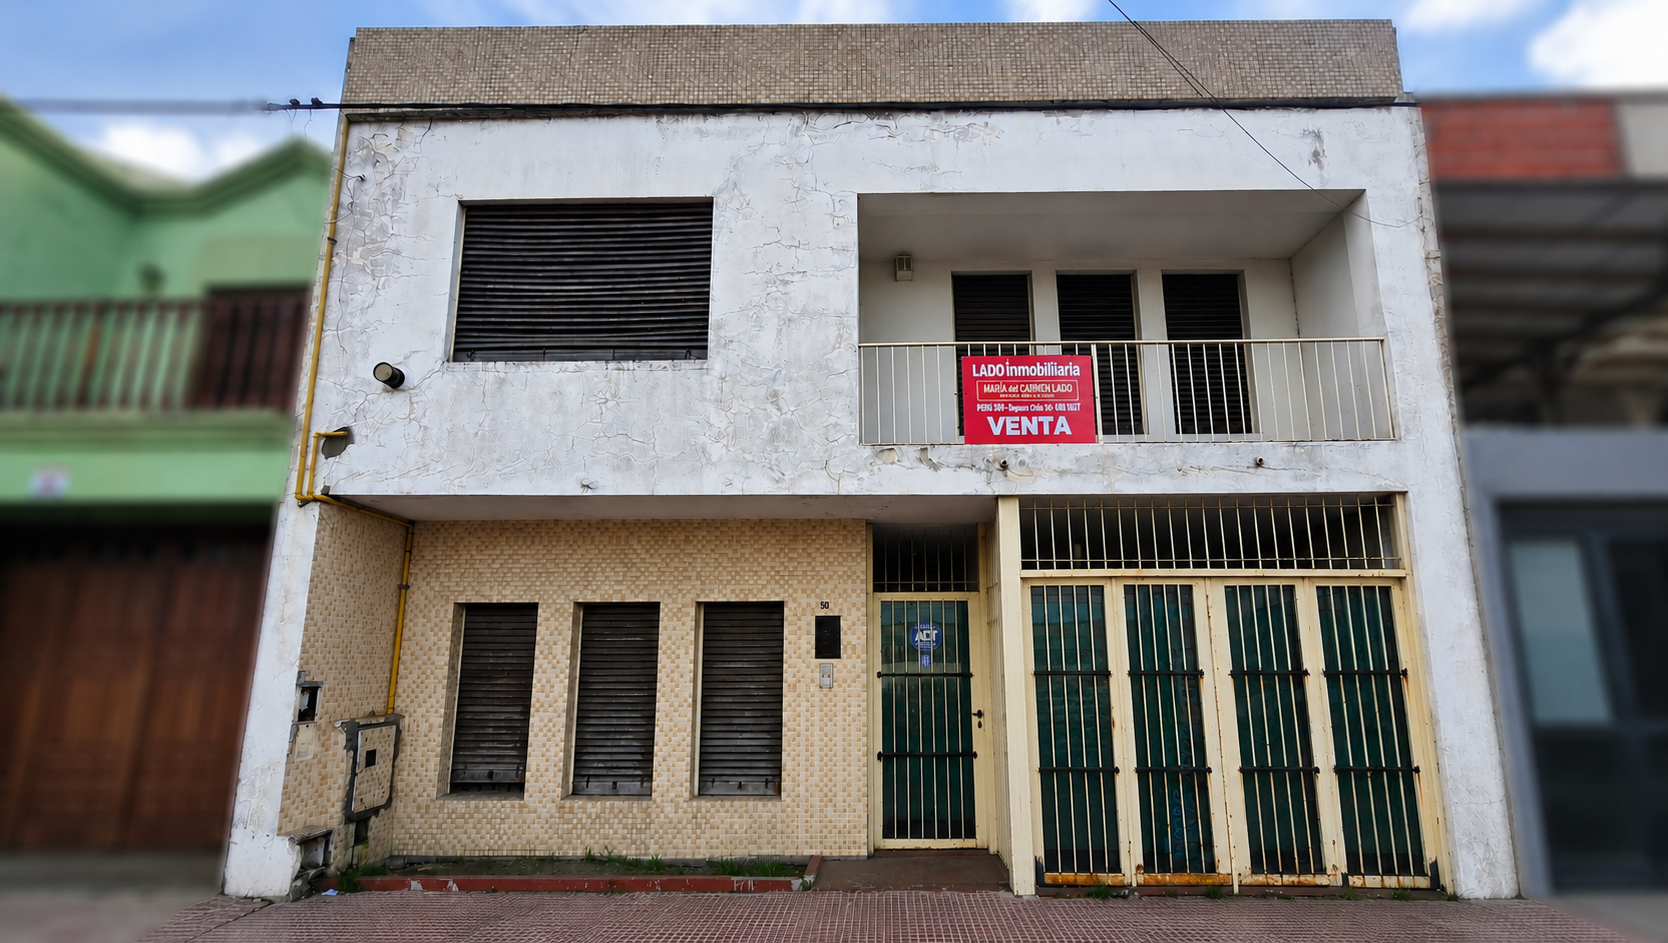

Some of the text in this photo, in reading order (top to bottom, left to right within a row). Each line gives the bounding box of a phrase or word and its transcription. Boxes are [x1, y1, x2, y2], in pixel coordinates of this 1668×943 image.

[972, 363, 1004, 377] LADO
[1052, 383, 1073, 392] LADO
[986, 415, 1072, 436] VENTA
[820, 601, 830, 610] 50
[914, 630, 938, 641] ADT
